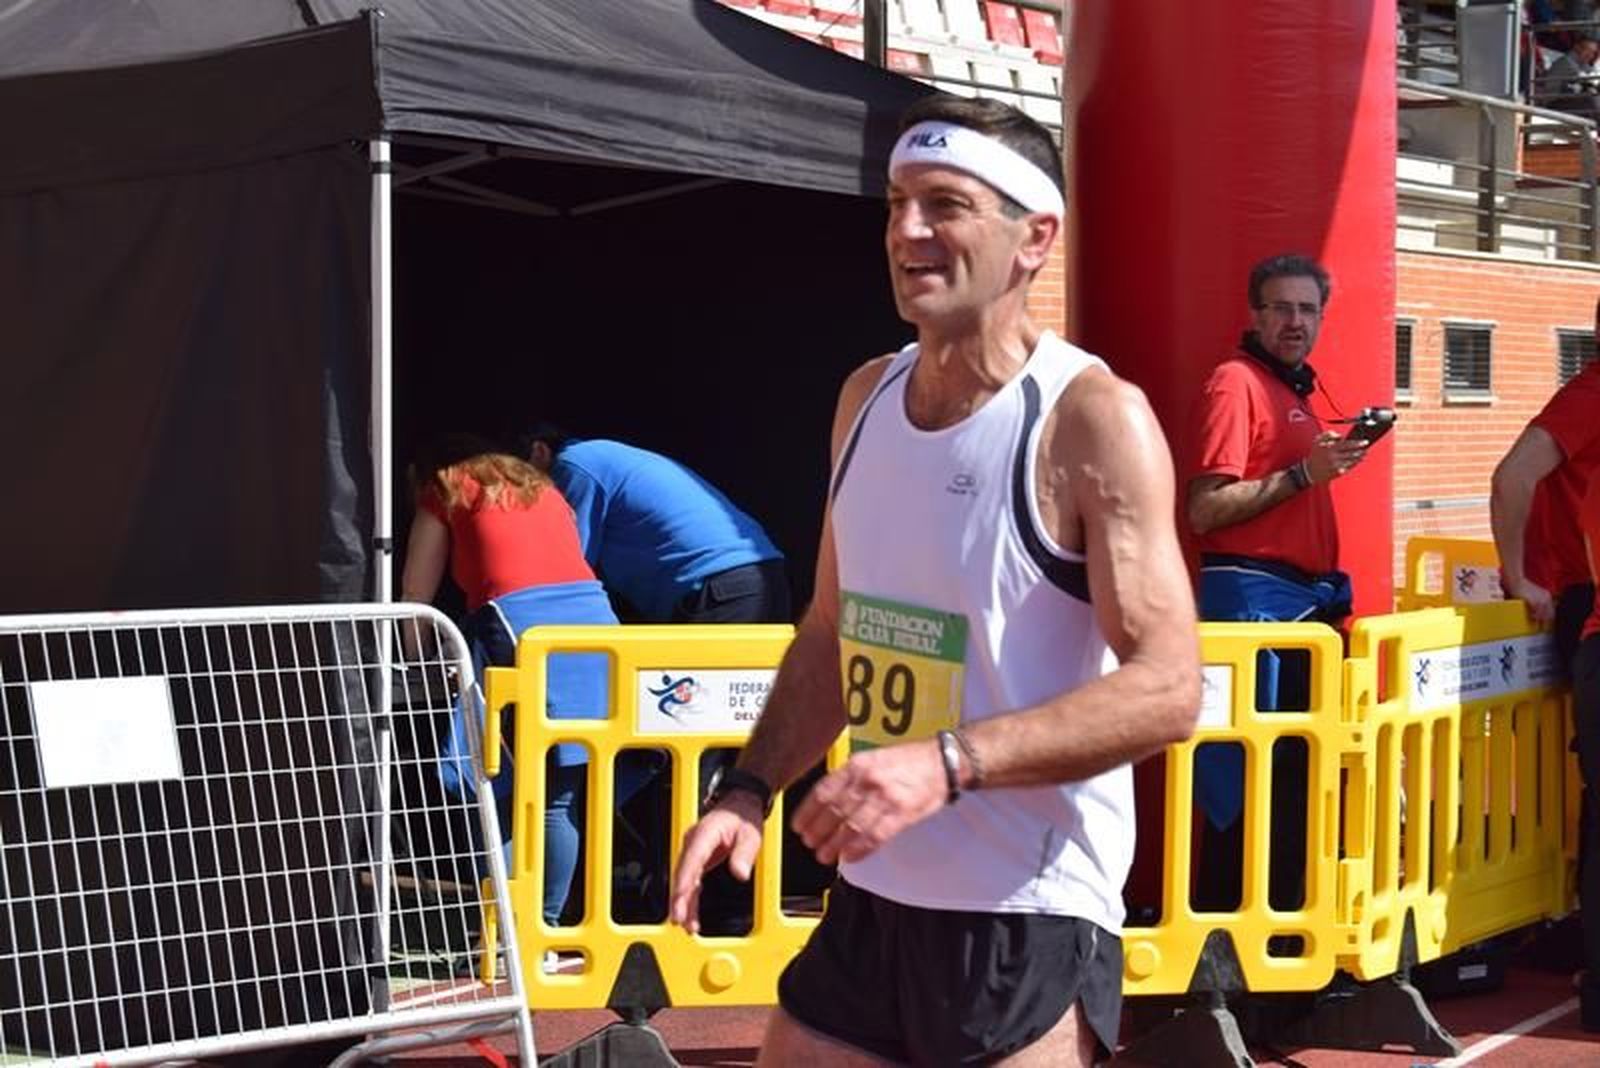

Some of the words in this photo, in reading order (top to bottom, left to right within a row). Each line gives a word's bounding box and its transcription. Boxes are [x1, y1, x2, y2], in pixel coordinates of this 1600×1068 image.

[906, 132, 948, 149] FILA
[729, 695, 745, 707] DE
[847, 654, 916, 737] 89
